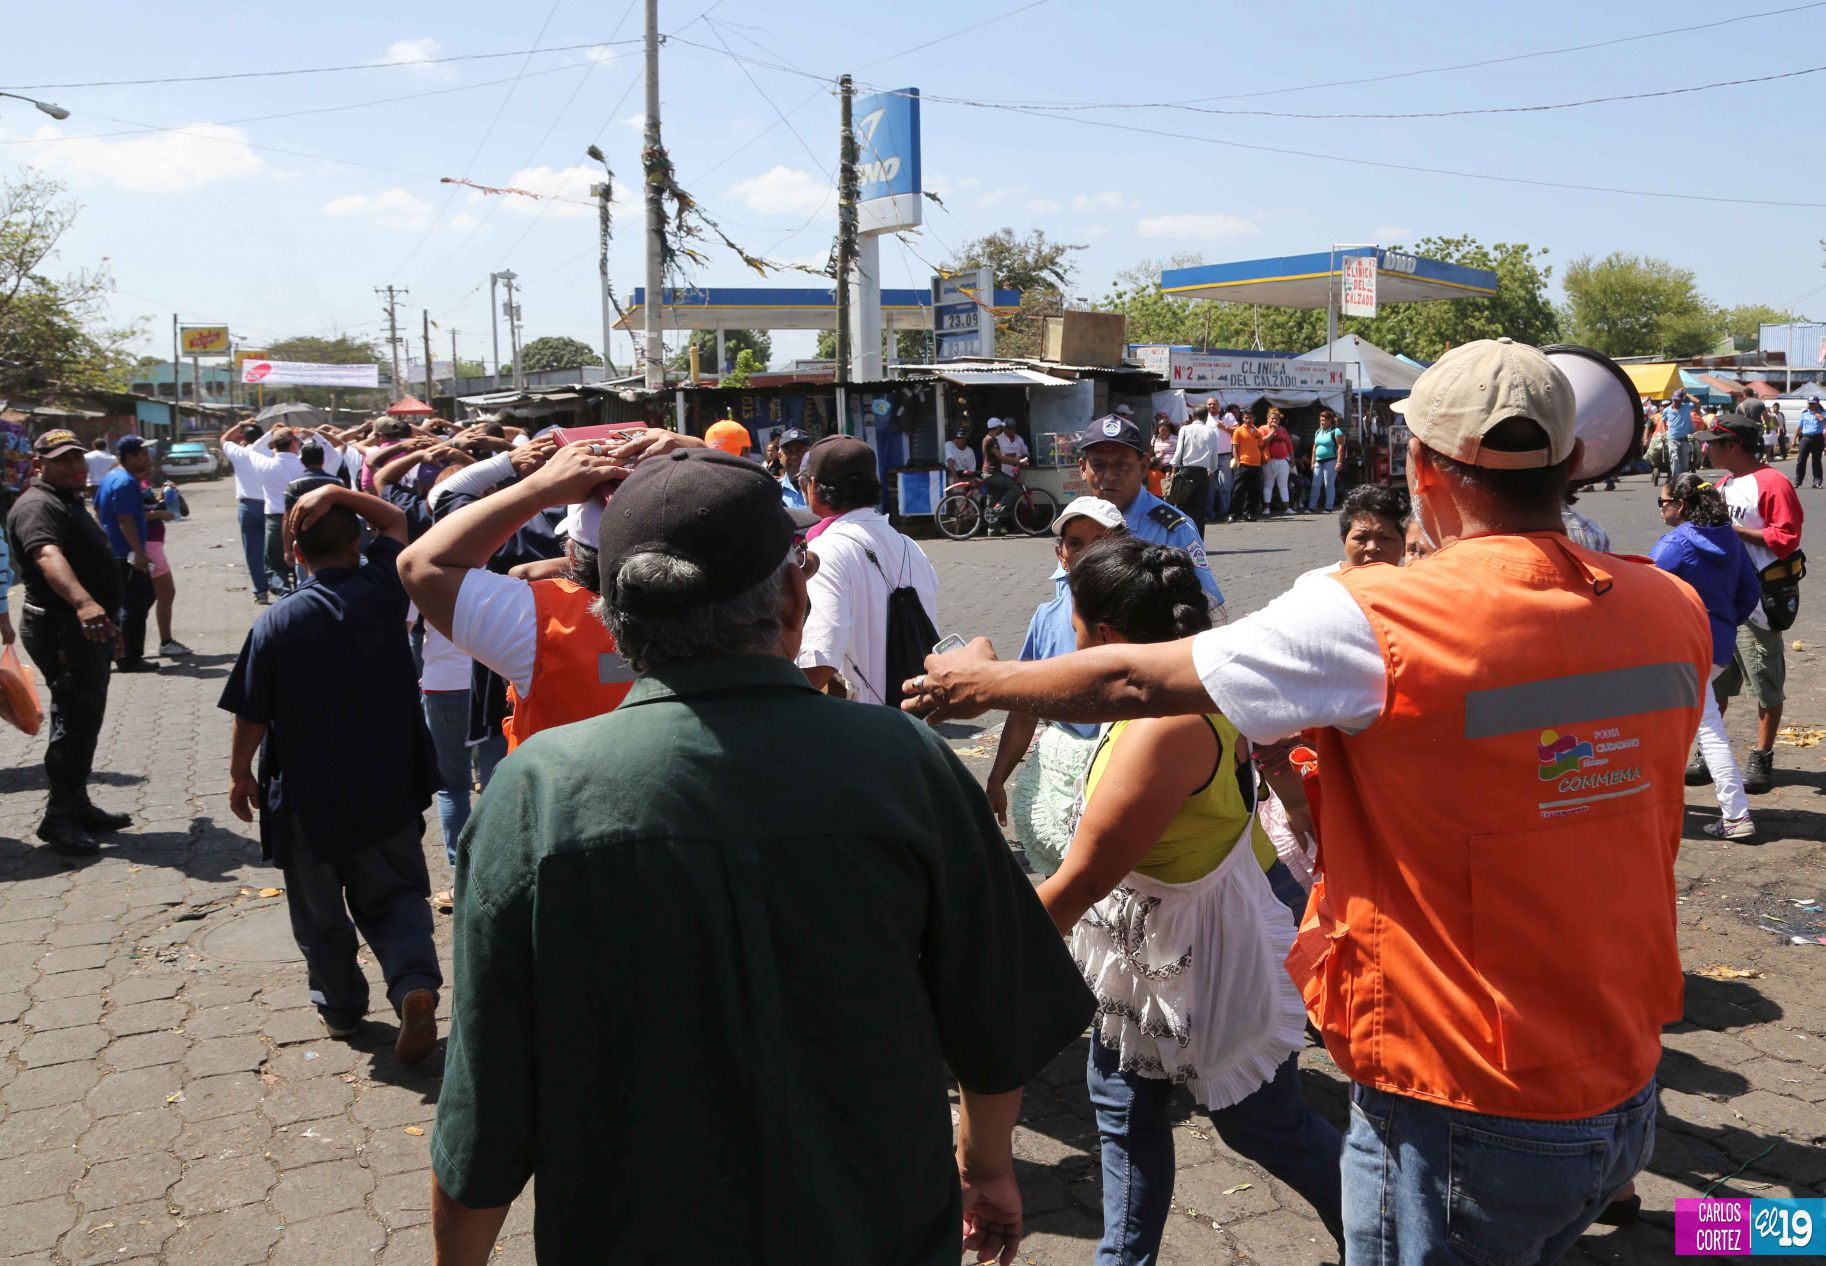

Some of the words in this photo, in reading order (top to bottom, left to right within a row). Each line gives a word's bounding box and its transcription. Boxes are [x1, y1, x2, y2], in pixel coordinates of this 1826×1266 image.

[856, 156, 901, 187] NO
[1382, 250, 1417, 274] UNO
[1346, 266, 1373, 279] CLINICA
[1353, 279, 1366, 291] DEL
[1345, 292, 1374, 306] CALZADO
[948, 313, 978, 328] 23.09
[947, 341, 974, 356] 23.12
[1241, 361, 1286, 376] CLINICA
[1230, 374, 1250, 387] DEL
[1254, 374, 1297, 388] CALZADO
[1558, 767, 1641, 793] COMMEMA
